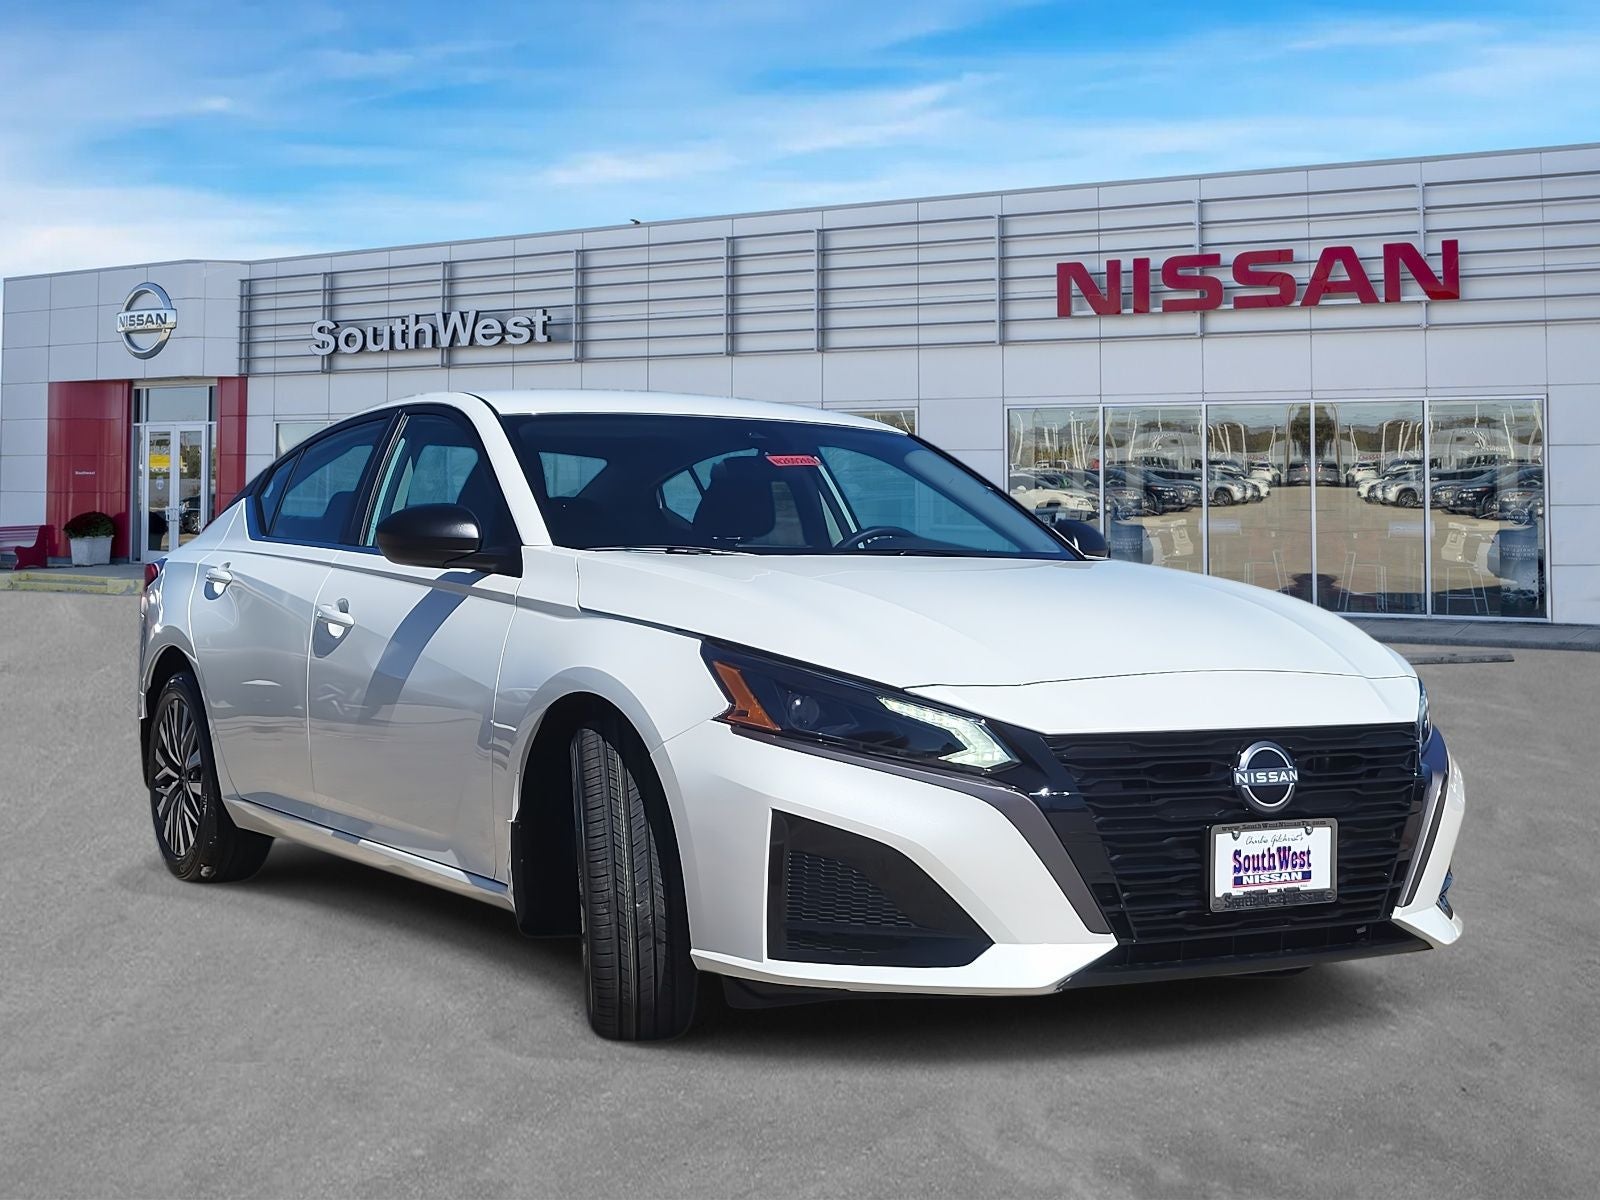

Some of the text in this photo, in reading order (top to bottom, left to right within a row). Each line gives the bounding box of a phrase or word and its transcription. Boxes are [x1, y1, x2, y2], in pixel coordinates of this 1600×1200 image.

[1057, 239, 1461, 317] NISSAN
[119, 312, 168, 328] NISSAN
[309, 308, 551, 356] SouthWest
[1235, 769, 1299, 784] NISSAN
[1232, 844, 1312, 875] SouthWest
[1242, 871, 1303, 885] NISSAN
